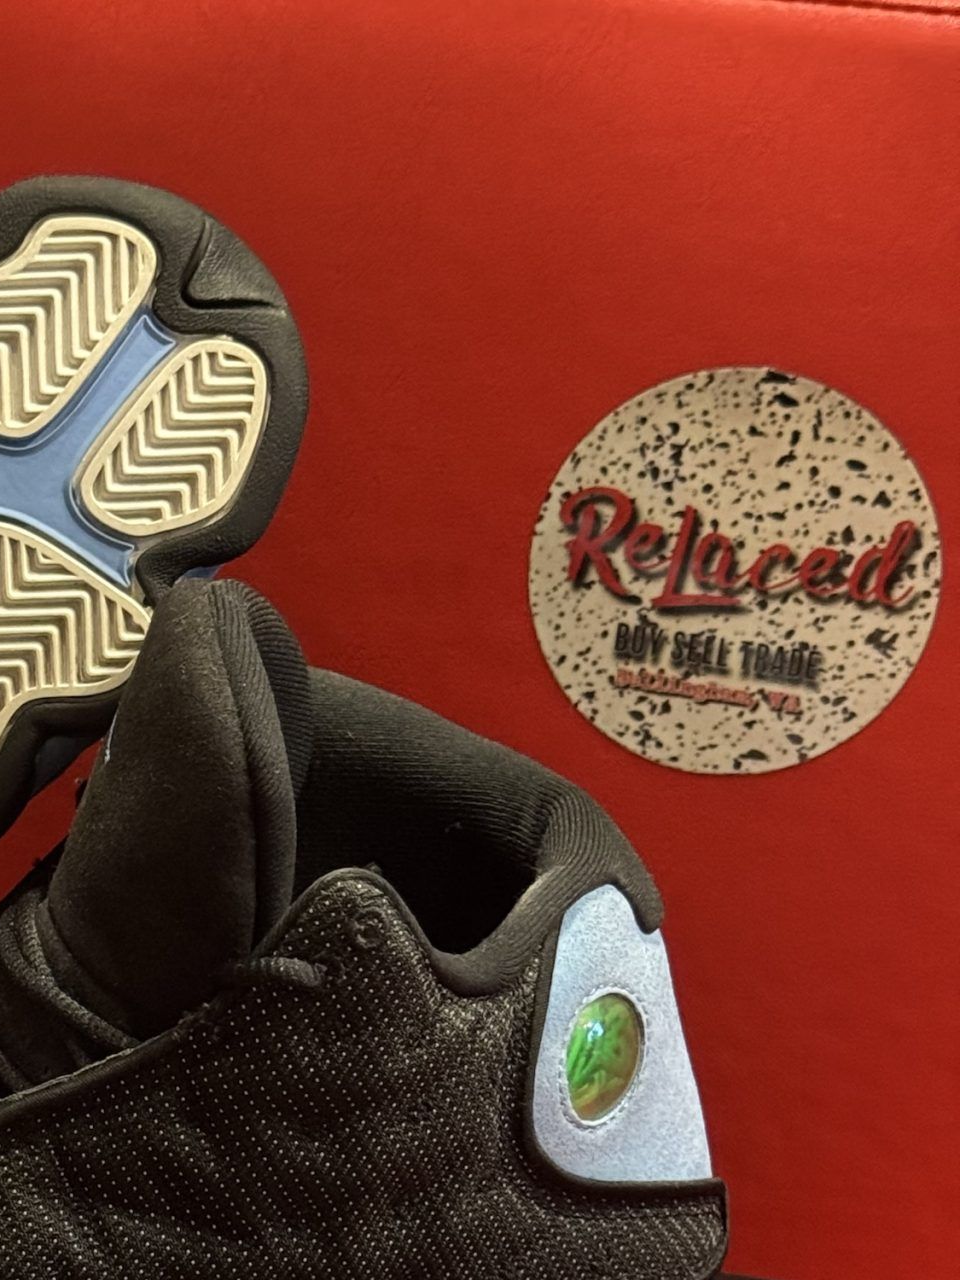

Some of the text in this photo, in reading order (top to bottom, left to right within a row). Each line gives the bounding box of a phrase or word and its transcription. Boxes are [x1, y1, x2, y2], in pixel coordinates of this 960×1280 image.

[559, 486, 916, 609] ReLaced
[614, 622, 823, 681] BUY SELL TRADE
